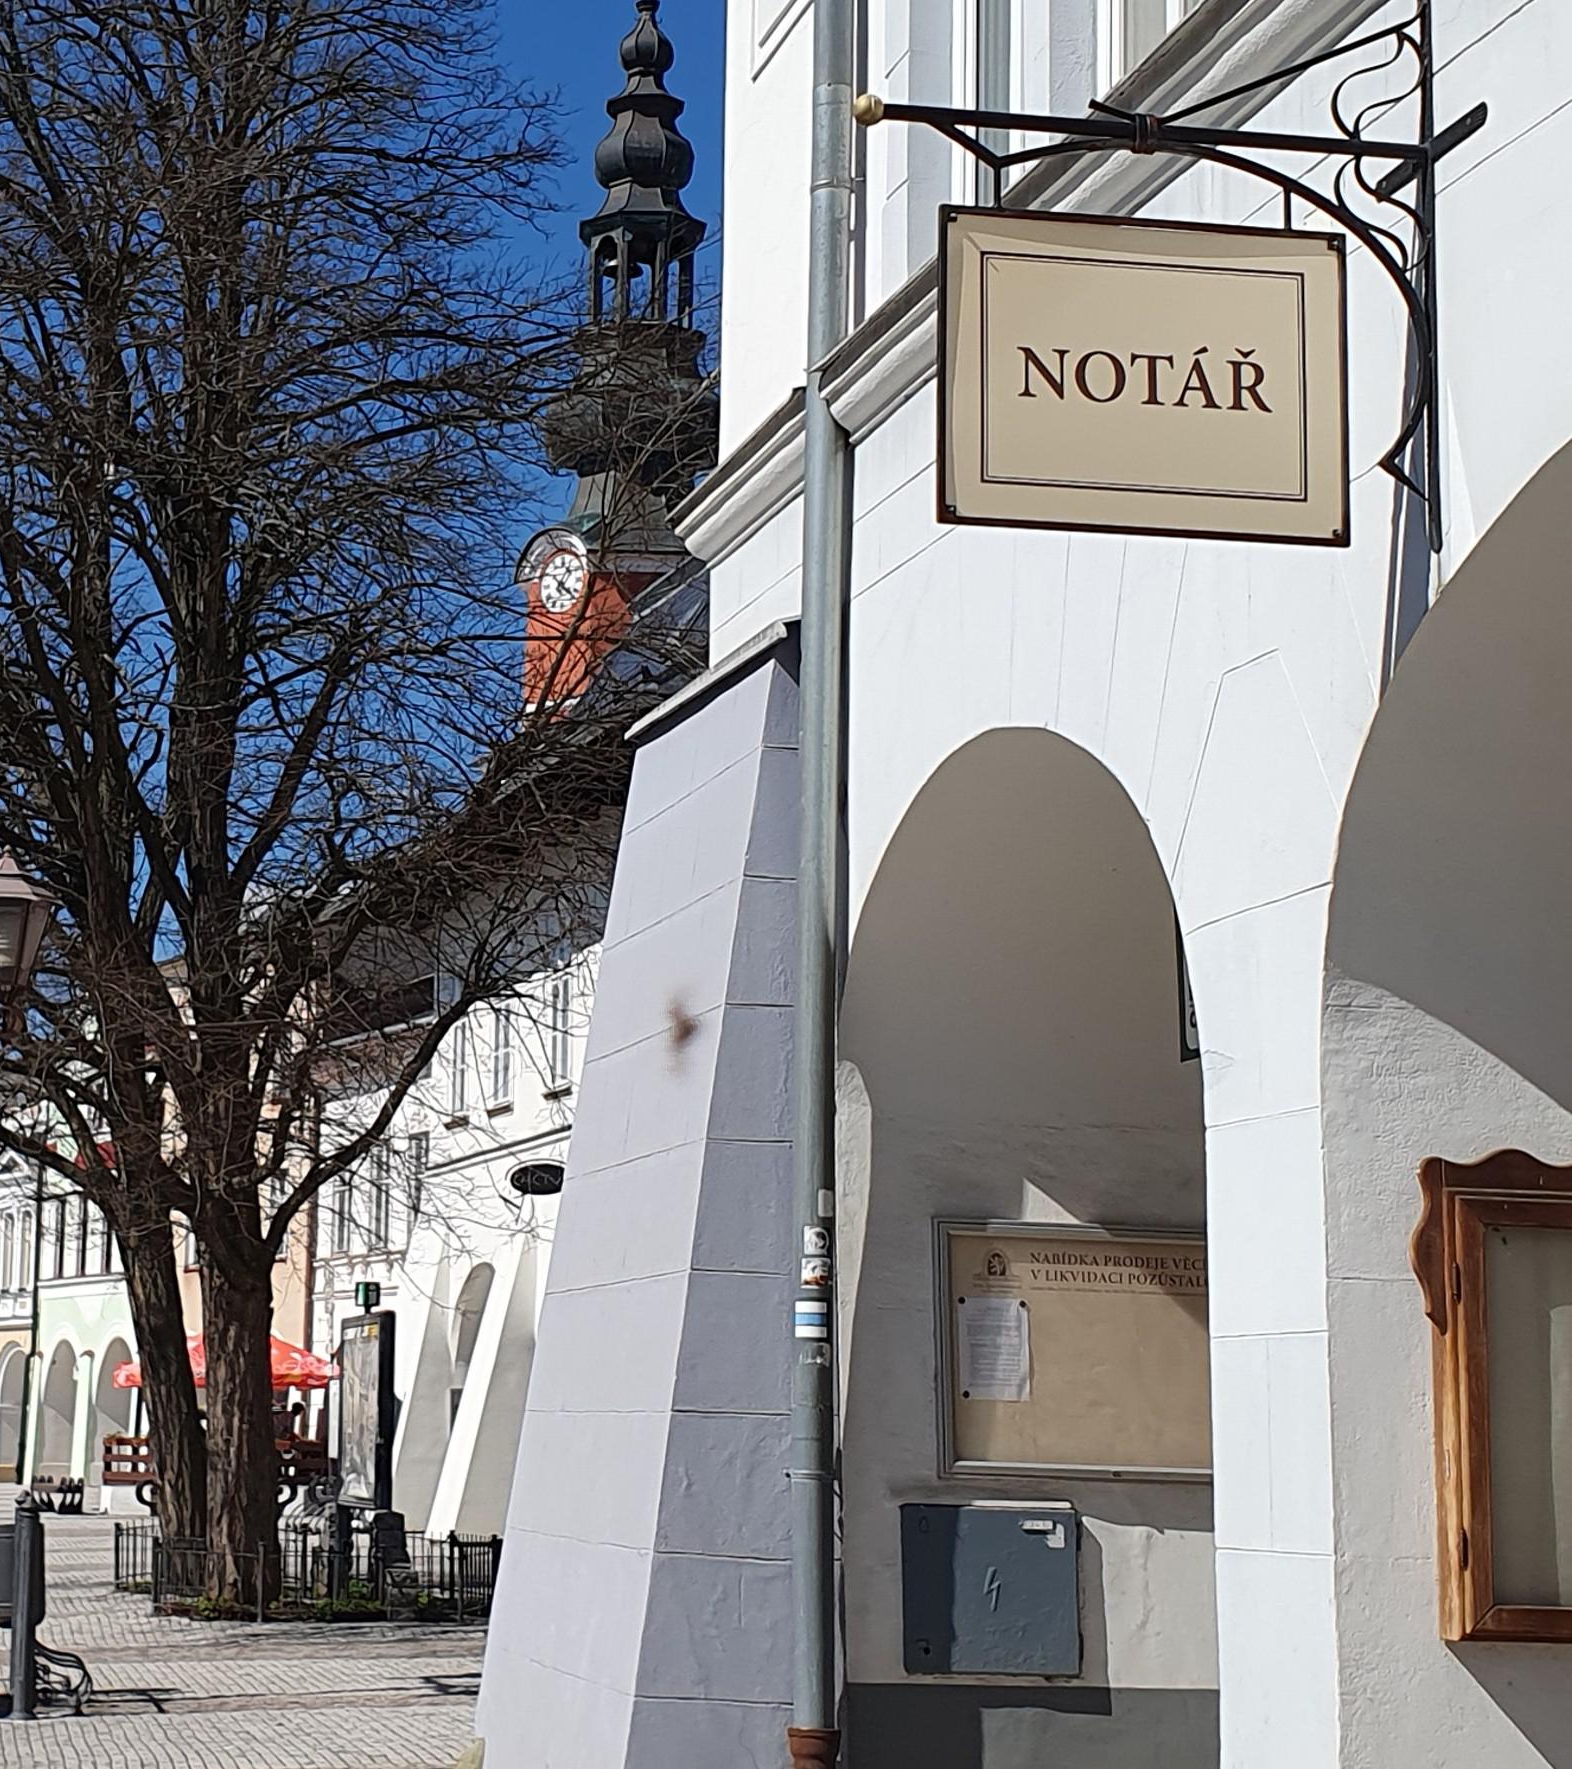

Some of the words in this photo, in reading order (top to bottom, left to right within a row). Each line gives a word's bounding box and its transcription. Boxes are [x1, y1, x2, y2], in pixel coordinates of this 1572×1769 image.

[1017, 346, 1273, 413] NOTÁŘ
[1030, 1251, 1100, 1267] NABÍDKA
[1104, 1254, 1169, 1270] PRODEJE
[1030, 1269, 1041, 1280] V
[1045, 1269, 1123, 1284] LIKVIDACI
